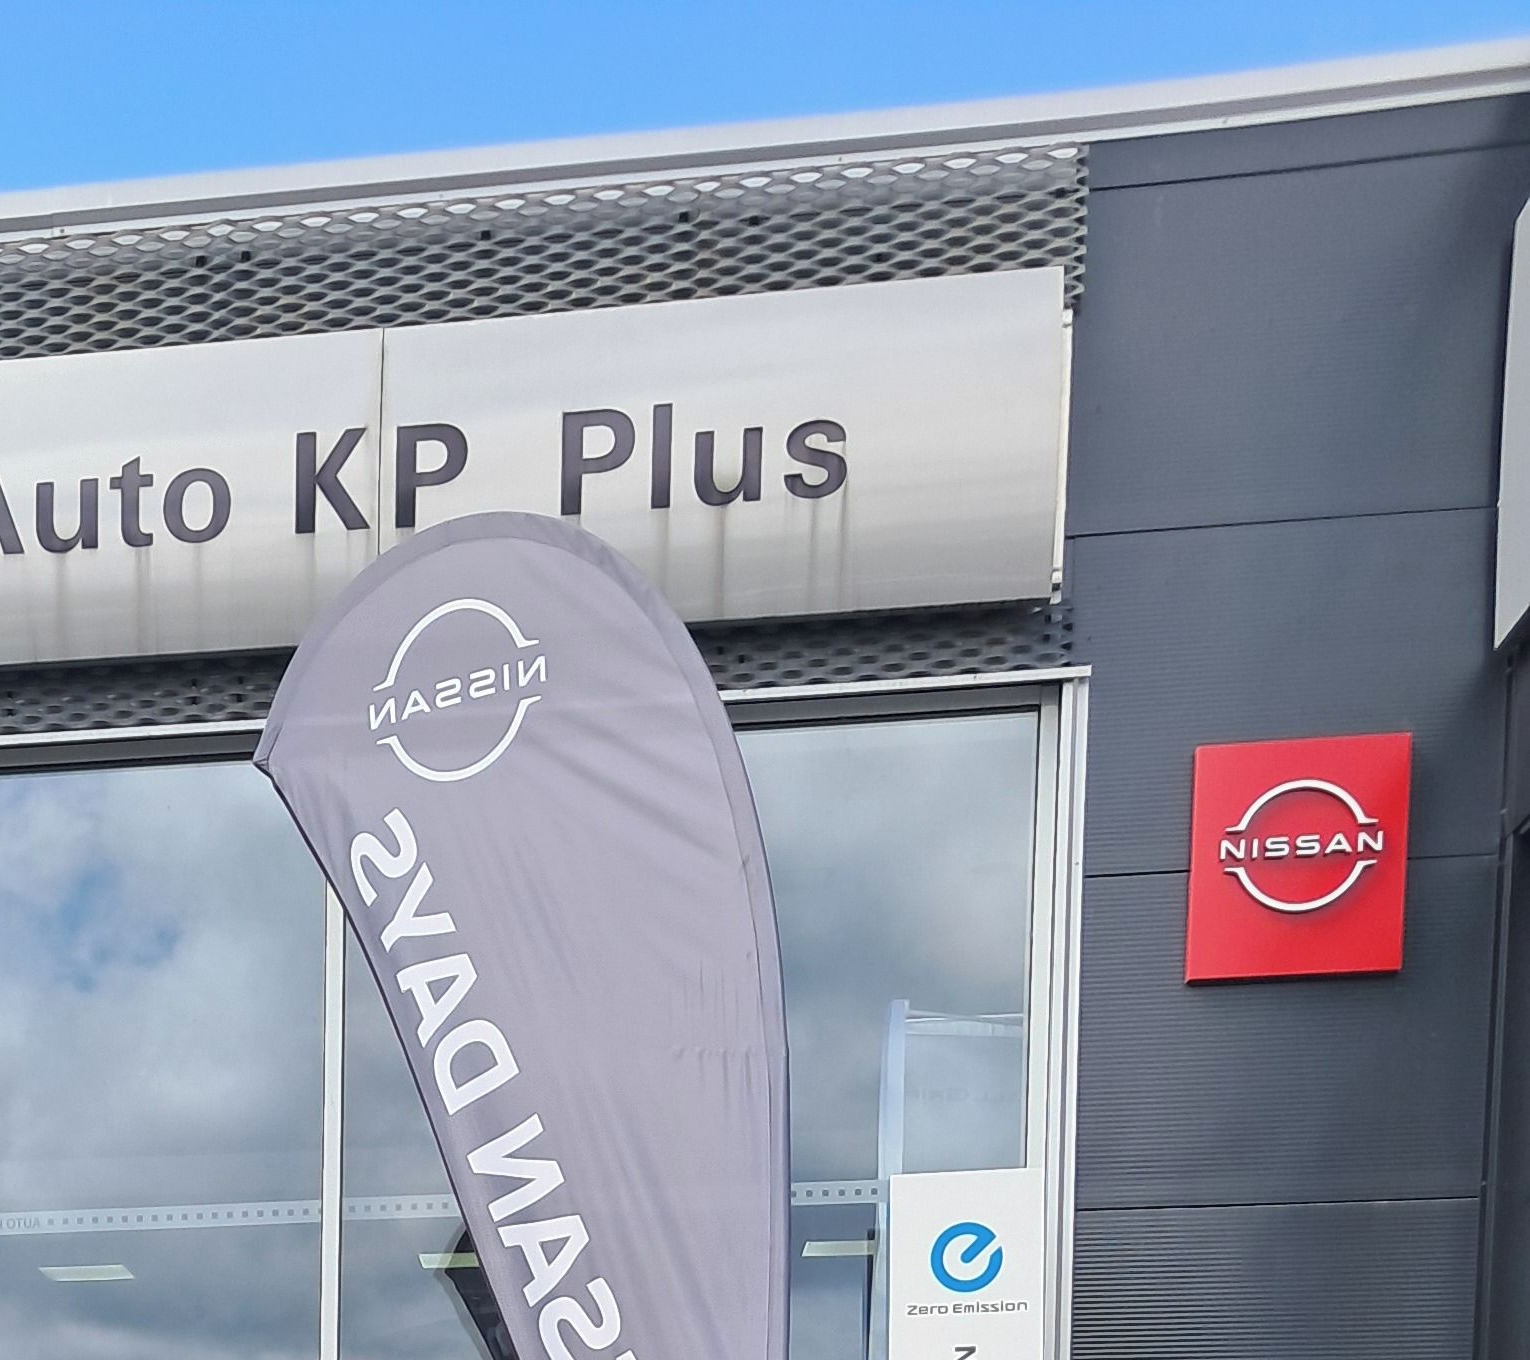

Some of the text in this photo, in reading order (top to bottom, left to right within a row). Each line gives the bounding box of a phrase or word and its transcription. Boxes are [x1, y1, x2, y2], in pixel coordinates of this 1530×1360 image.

[294, 422, 470, 536] KP
[560, 403, 849, 517] Plus
[1219, 830, 1384, 861] NISSAN
[907, 1304, 949, 1316] Zero
